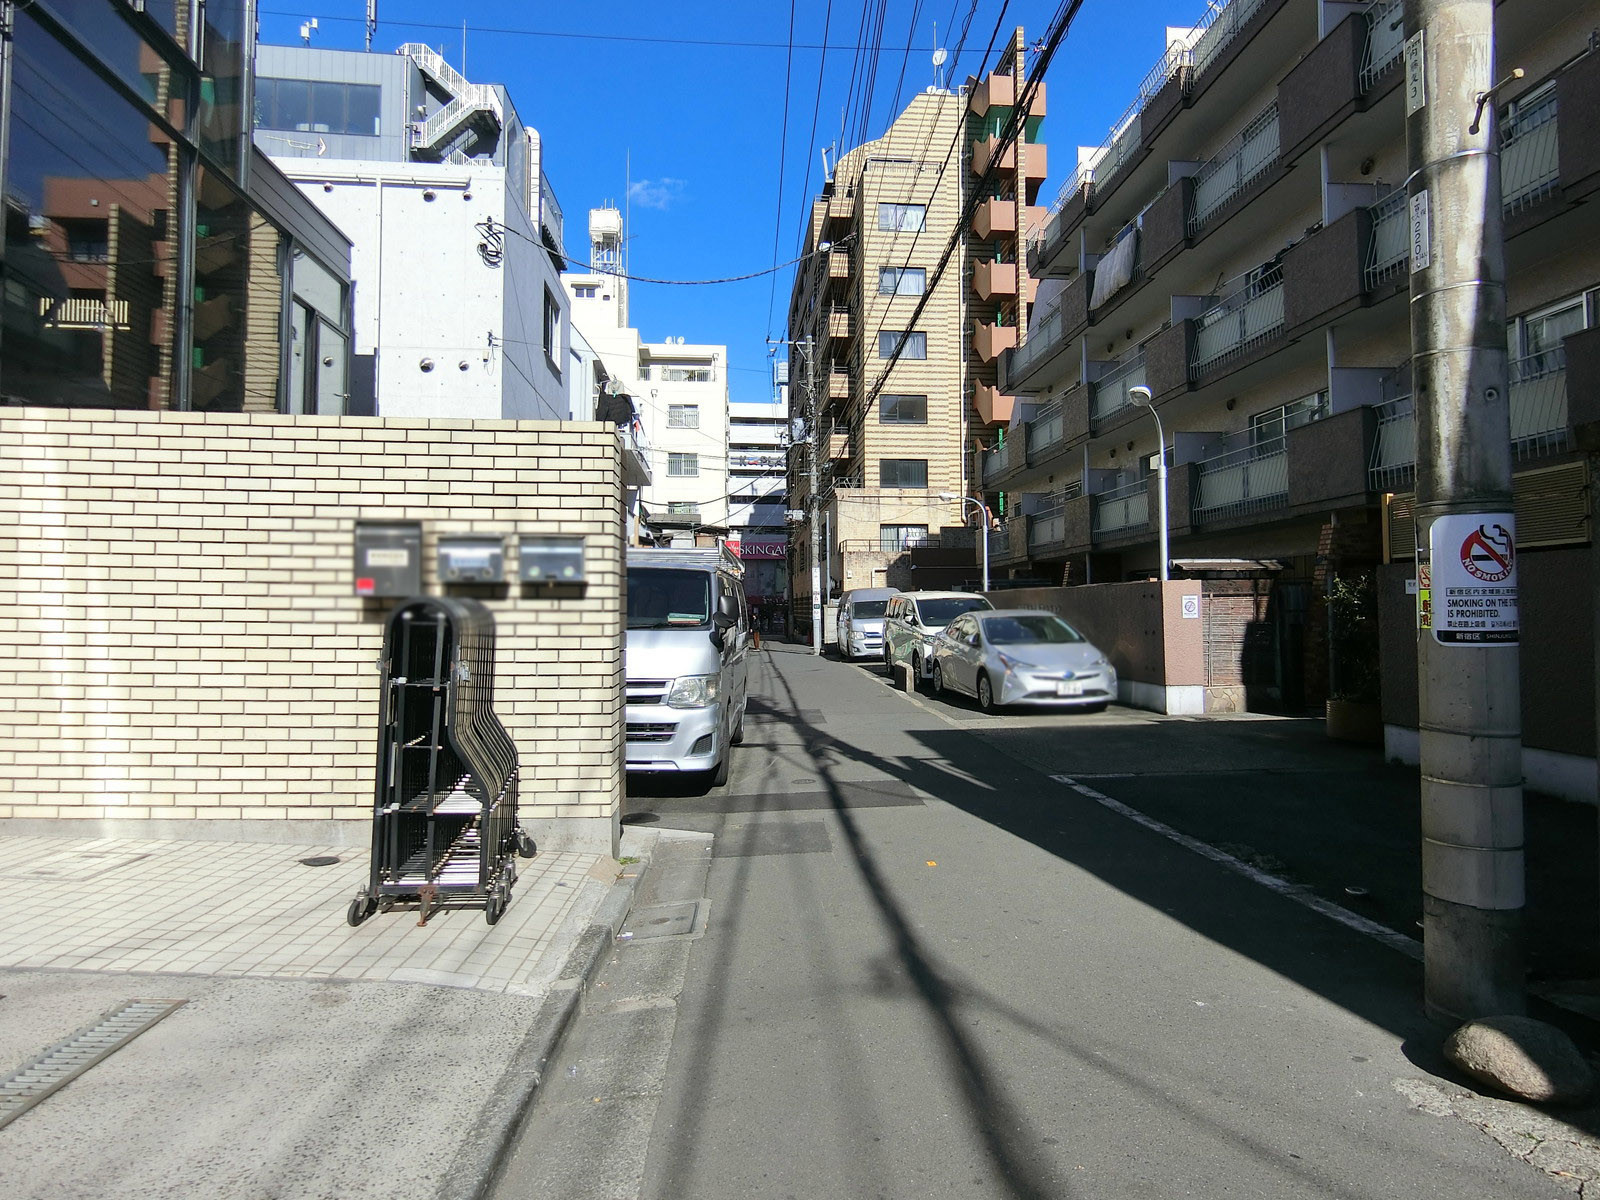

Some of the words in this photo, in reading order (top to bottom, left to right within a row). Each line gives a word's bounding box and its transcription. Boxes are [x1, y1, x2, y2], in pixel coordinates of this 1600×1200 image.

[1463, 558, 1476, 572] NO
[1447, 598, 1484, 608] SMOKING
[1485, 598, 1496, 608] ON
[1497, 598, 1508, 608] THE
[1447, 609, 1454, 618] IS
[1455, 609, 1501, 618] PROHIBITED.
[1455, 632, 1481, 640] 新宿区
